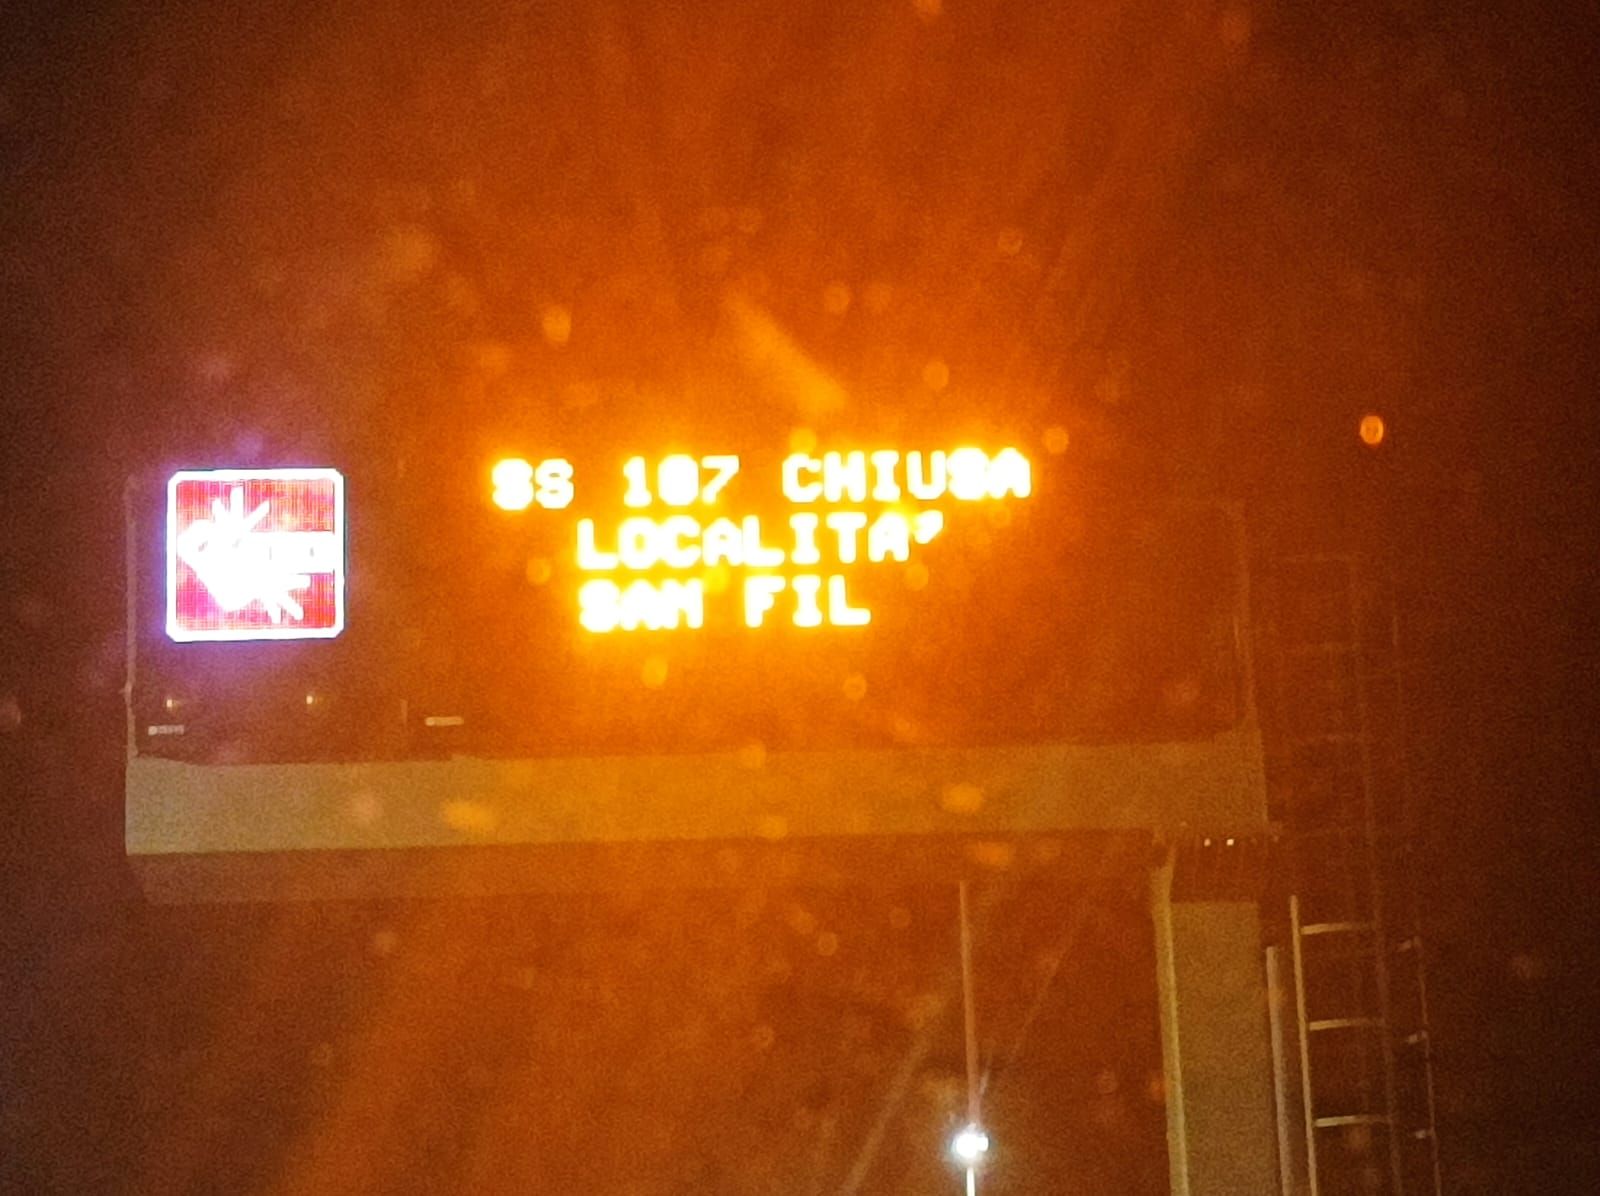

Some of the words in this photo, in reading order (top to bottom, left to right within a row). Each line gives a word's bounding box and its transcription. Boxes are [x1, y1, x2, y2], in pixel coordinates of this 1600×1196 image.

[492, 458, 575, 510] SS
[623, 455, 740, 506] 107
[782, 447, 1032, 503] CHIUSA
[744, 574, 871, 627] FIL
